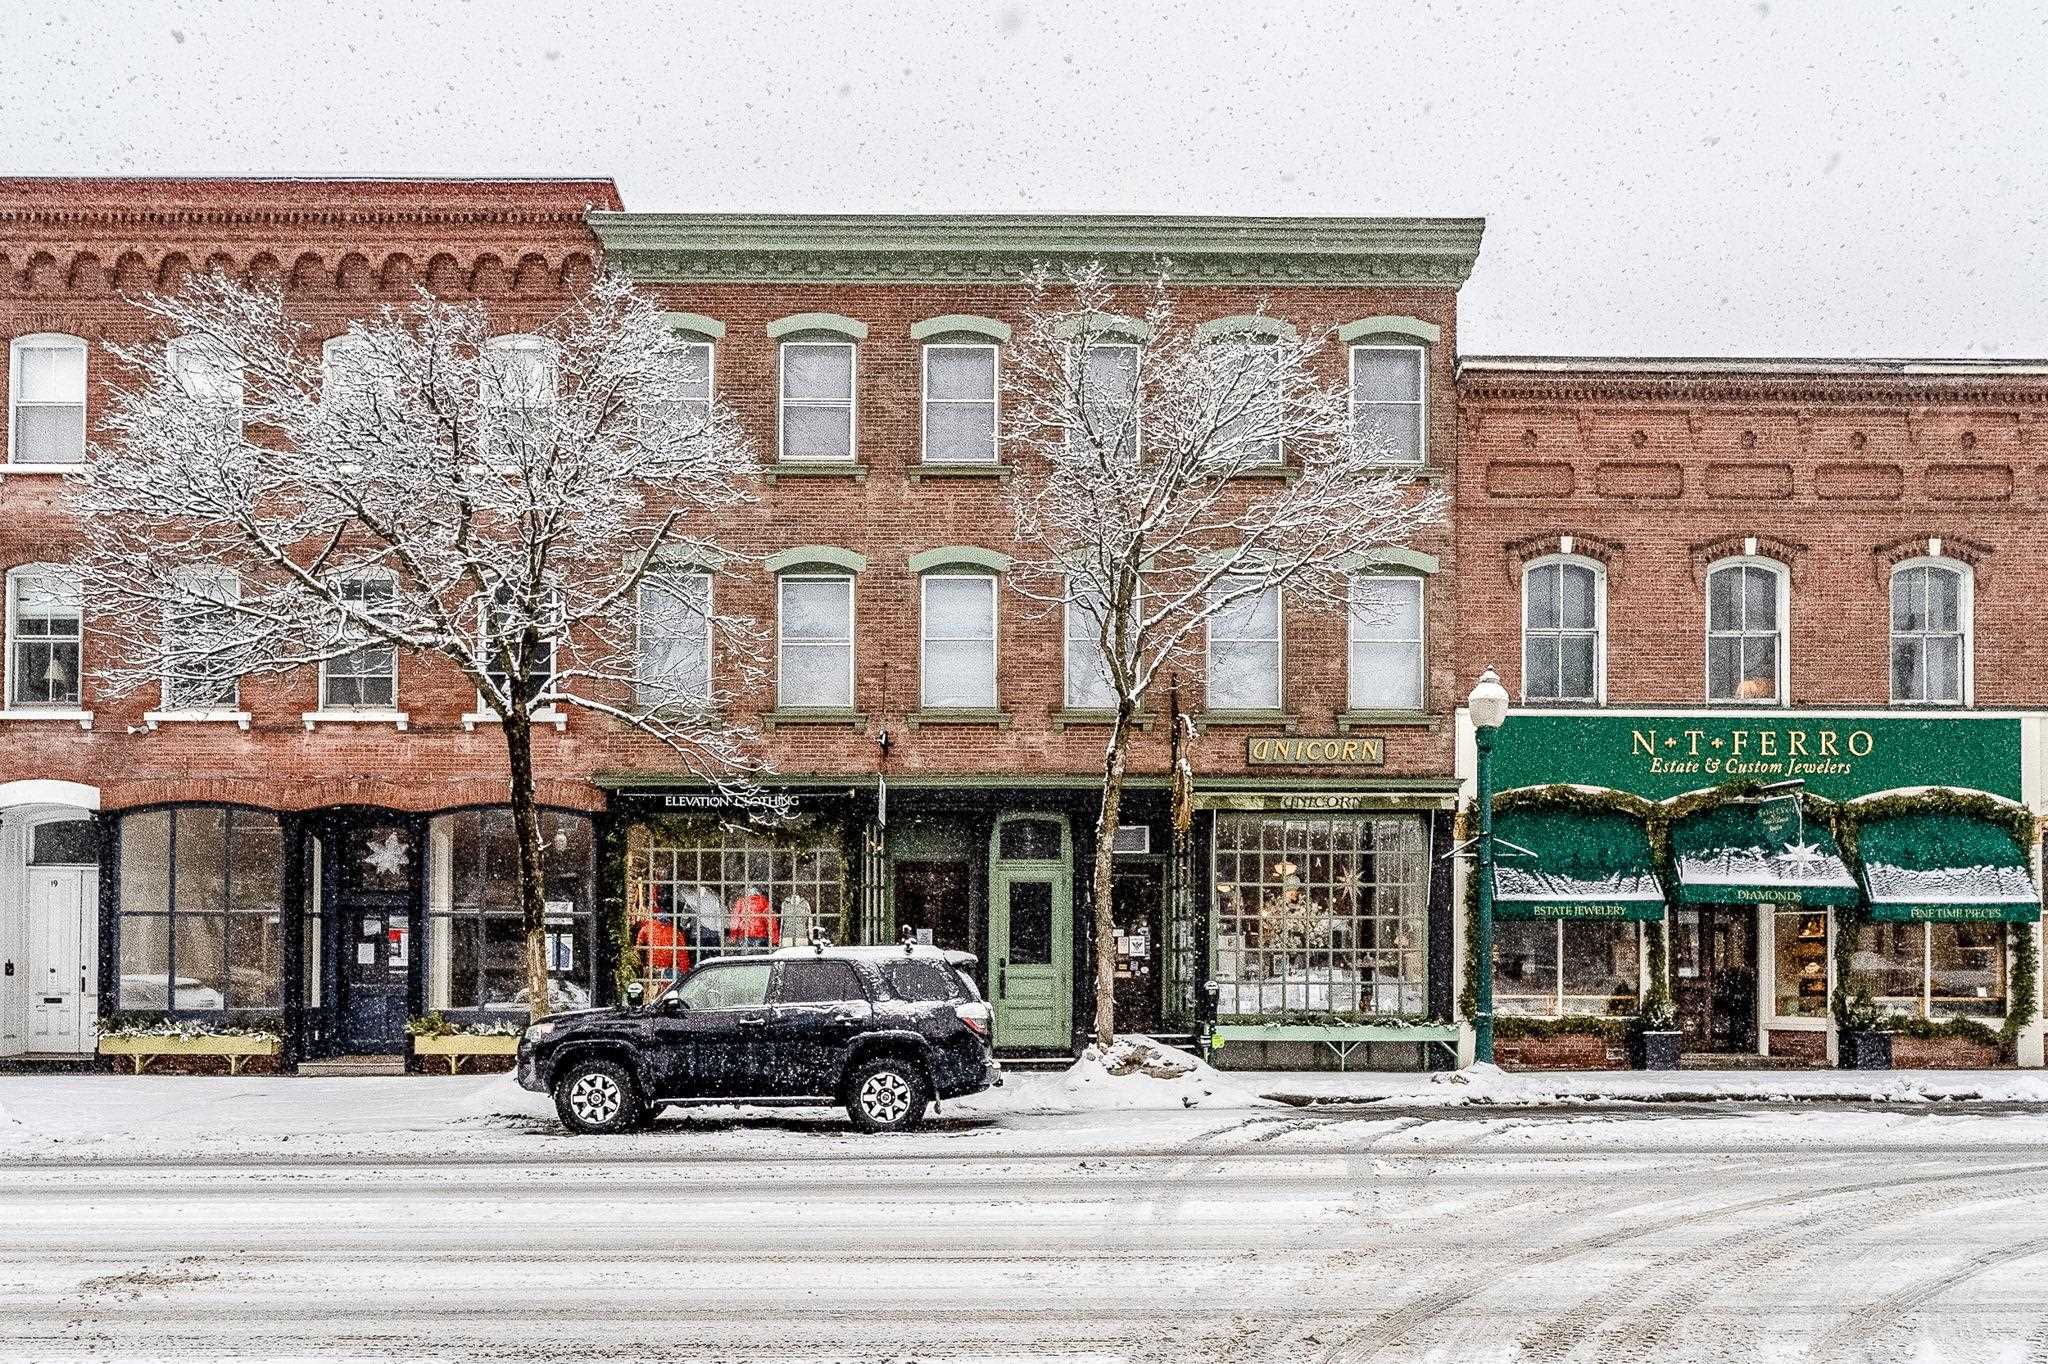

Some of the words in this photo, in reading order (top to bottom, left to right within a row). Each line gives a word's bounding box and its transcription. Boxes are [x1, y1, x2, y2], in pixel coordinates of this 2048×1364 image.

[1731, 730, 1873, 756] FERRO
[1253, 741, 1379, 760] UNICORN
[1649, 757, 1700, 773] Estate
[1704, 758, 1720, 773] &
[1725, 758, 1782, 774] Custom
[1784, 758, 1851, 776] Jewelers
[665, 796, 729, 806] ELEVATION
[1738, 889, 1802, 901] DIAMONDS
[1534, 906, 1572, 915] ESTATE
[1911, 908, 1935, 918] FINE
[1936, 908, 1963, 918] TIME
[1965, 908, 2001, 918] PIECES
